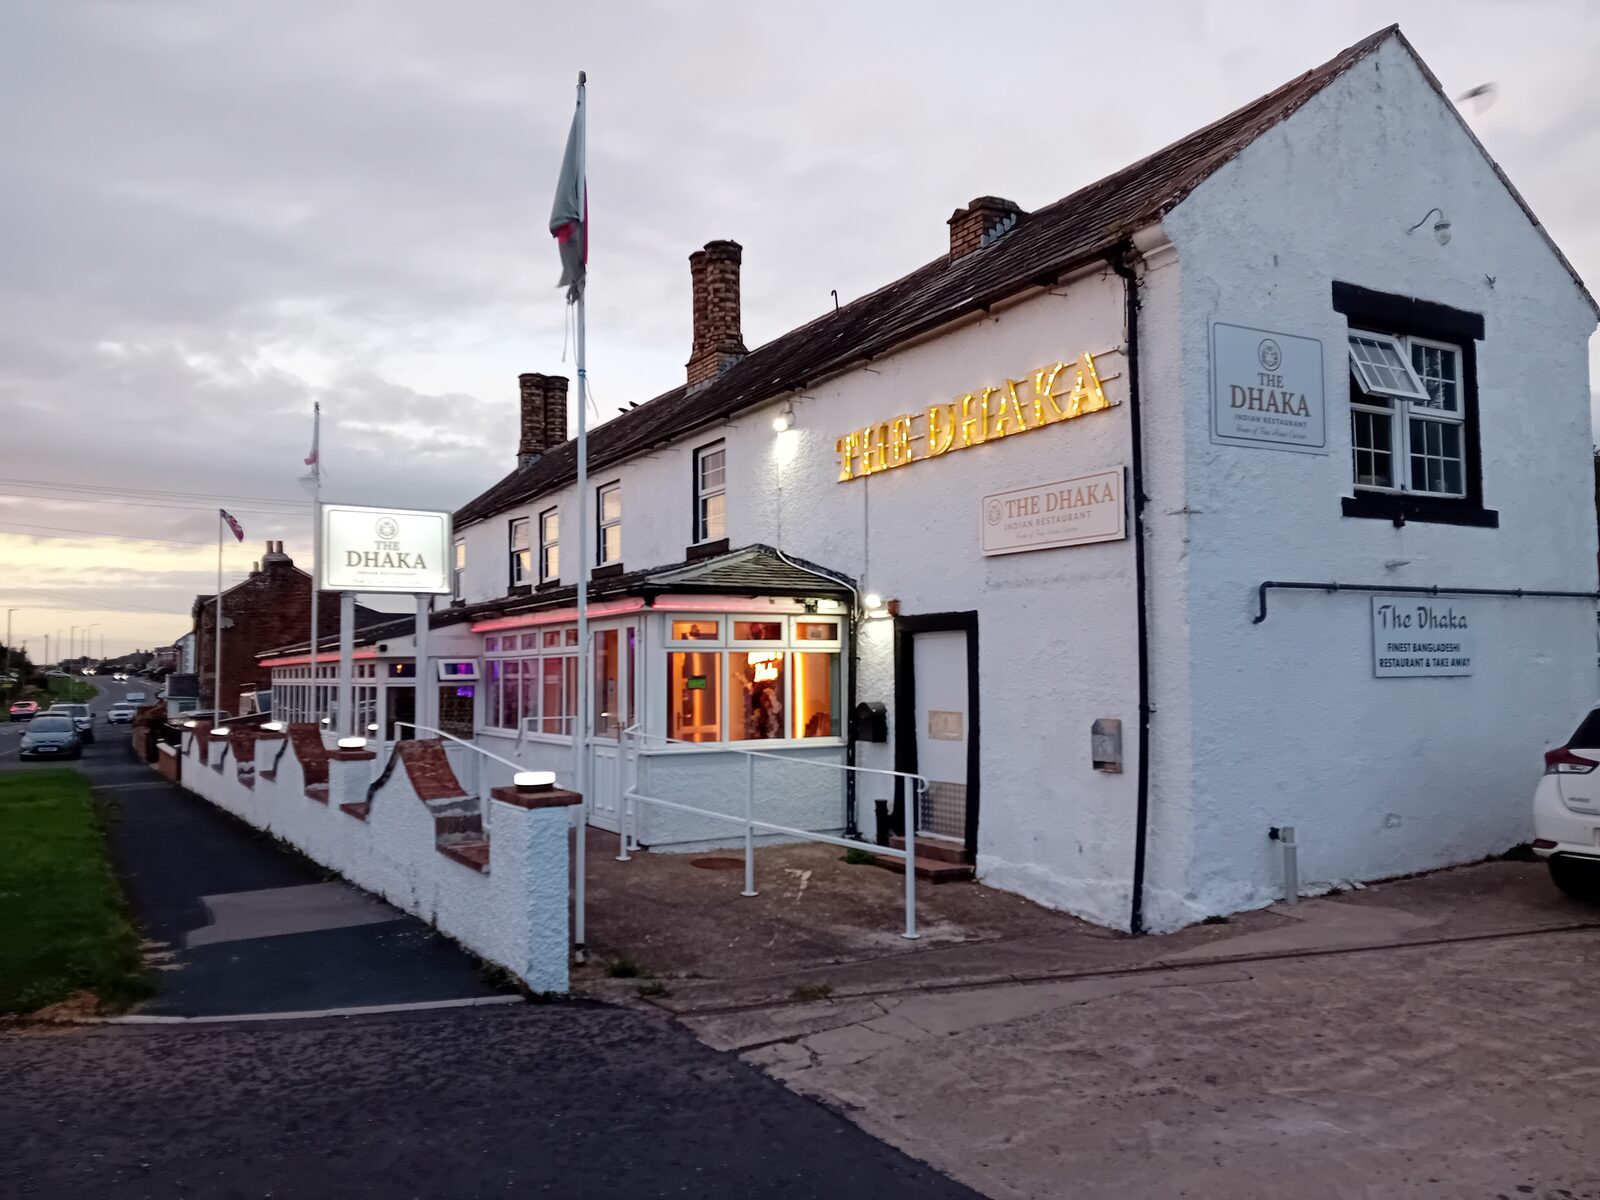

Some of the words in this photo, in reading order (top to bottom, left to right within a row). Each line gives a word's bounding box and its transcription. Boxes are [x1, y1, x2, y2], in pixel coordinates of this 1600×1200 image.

[1257, 372, 1284, 388] THE
[1230, 384, 1311, 417] DHAKA
[835, 414, 912, 483] THE
[924, 352, 1110, 457] DHAKA
[1234, 414, 1261, 423] INDIAN
[1263, 416, 1307, 428] RESTAURANT
[1004, 495, 1040, 519] THE
[1046, 481, 1115, 513] DHAKA
[1004, 519, 1033, 531] INDIAN
[1036, 510, 1092, 527] RESTAURANT
[374, 540, 400, 551] THE
[345, 550, 427, 569] DHAKA
[1378, 604, 1412, 630] The
[1416, 605, 1468, 630] Dhaka
[1387, 643, 1411, 652] FINEST
[1413, 643, 1461, 652] BANGLADESHI
[1379, 658, 1423, 668] RESTAURANT
[1425, 658, 1431, 667] &
[1432, 658, 1449, 667] TAKE
[1451, 658, 1471, 667] AWAY
